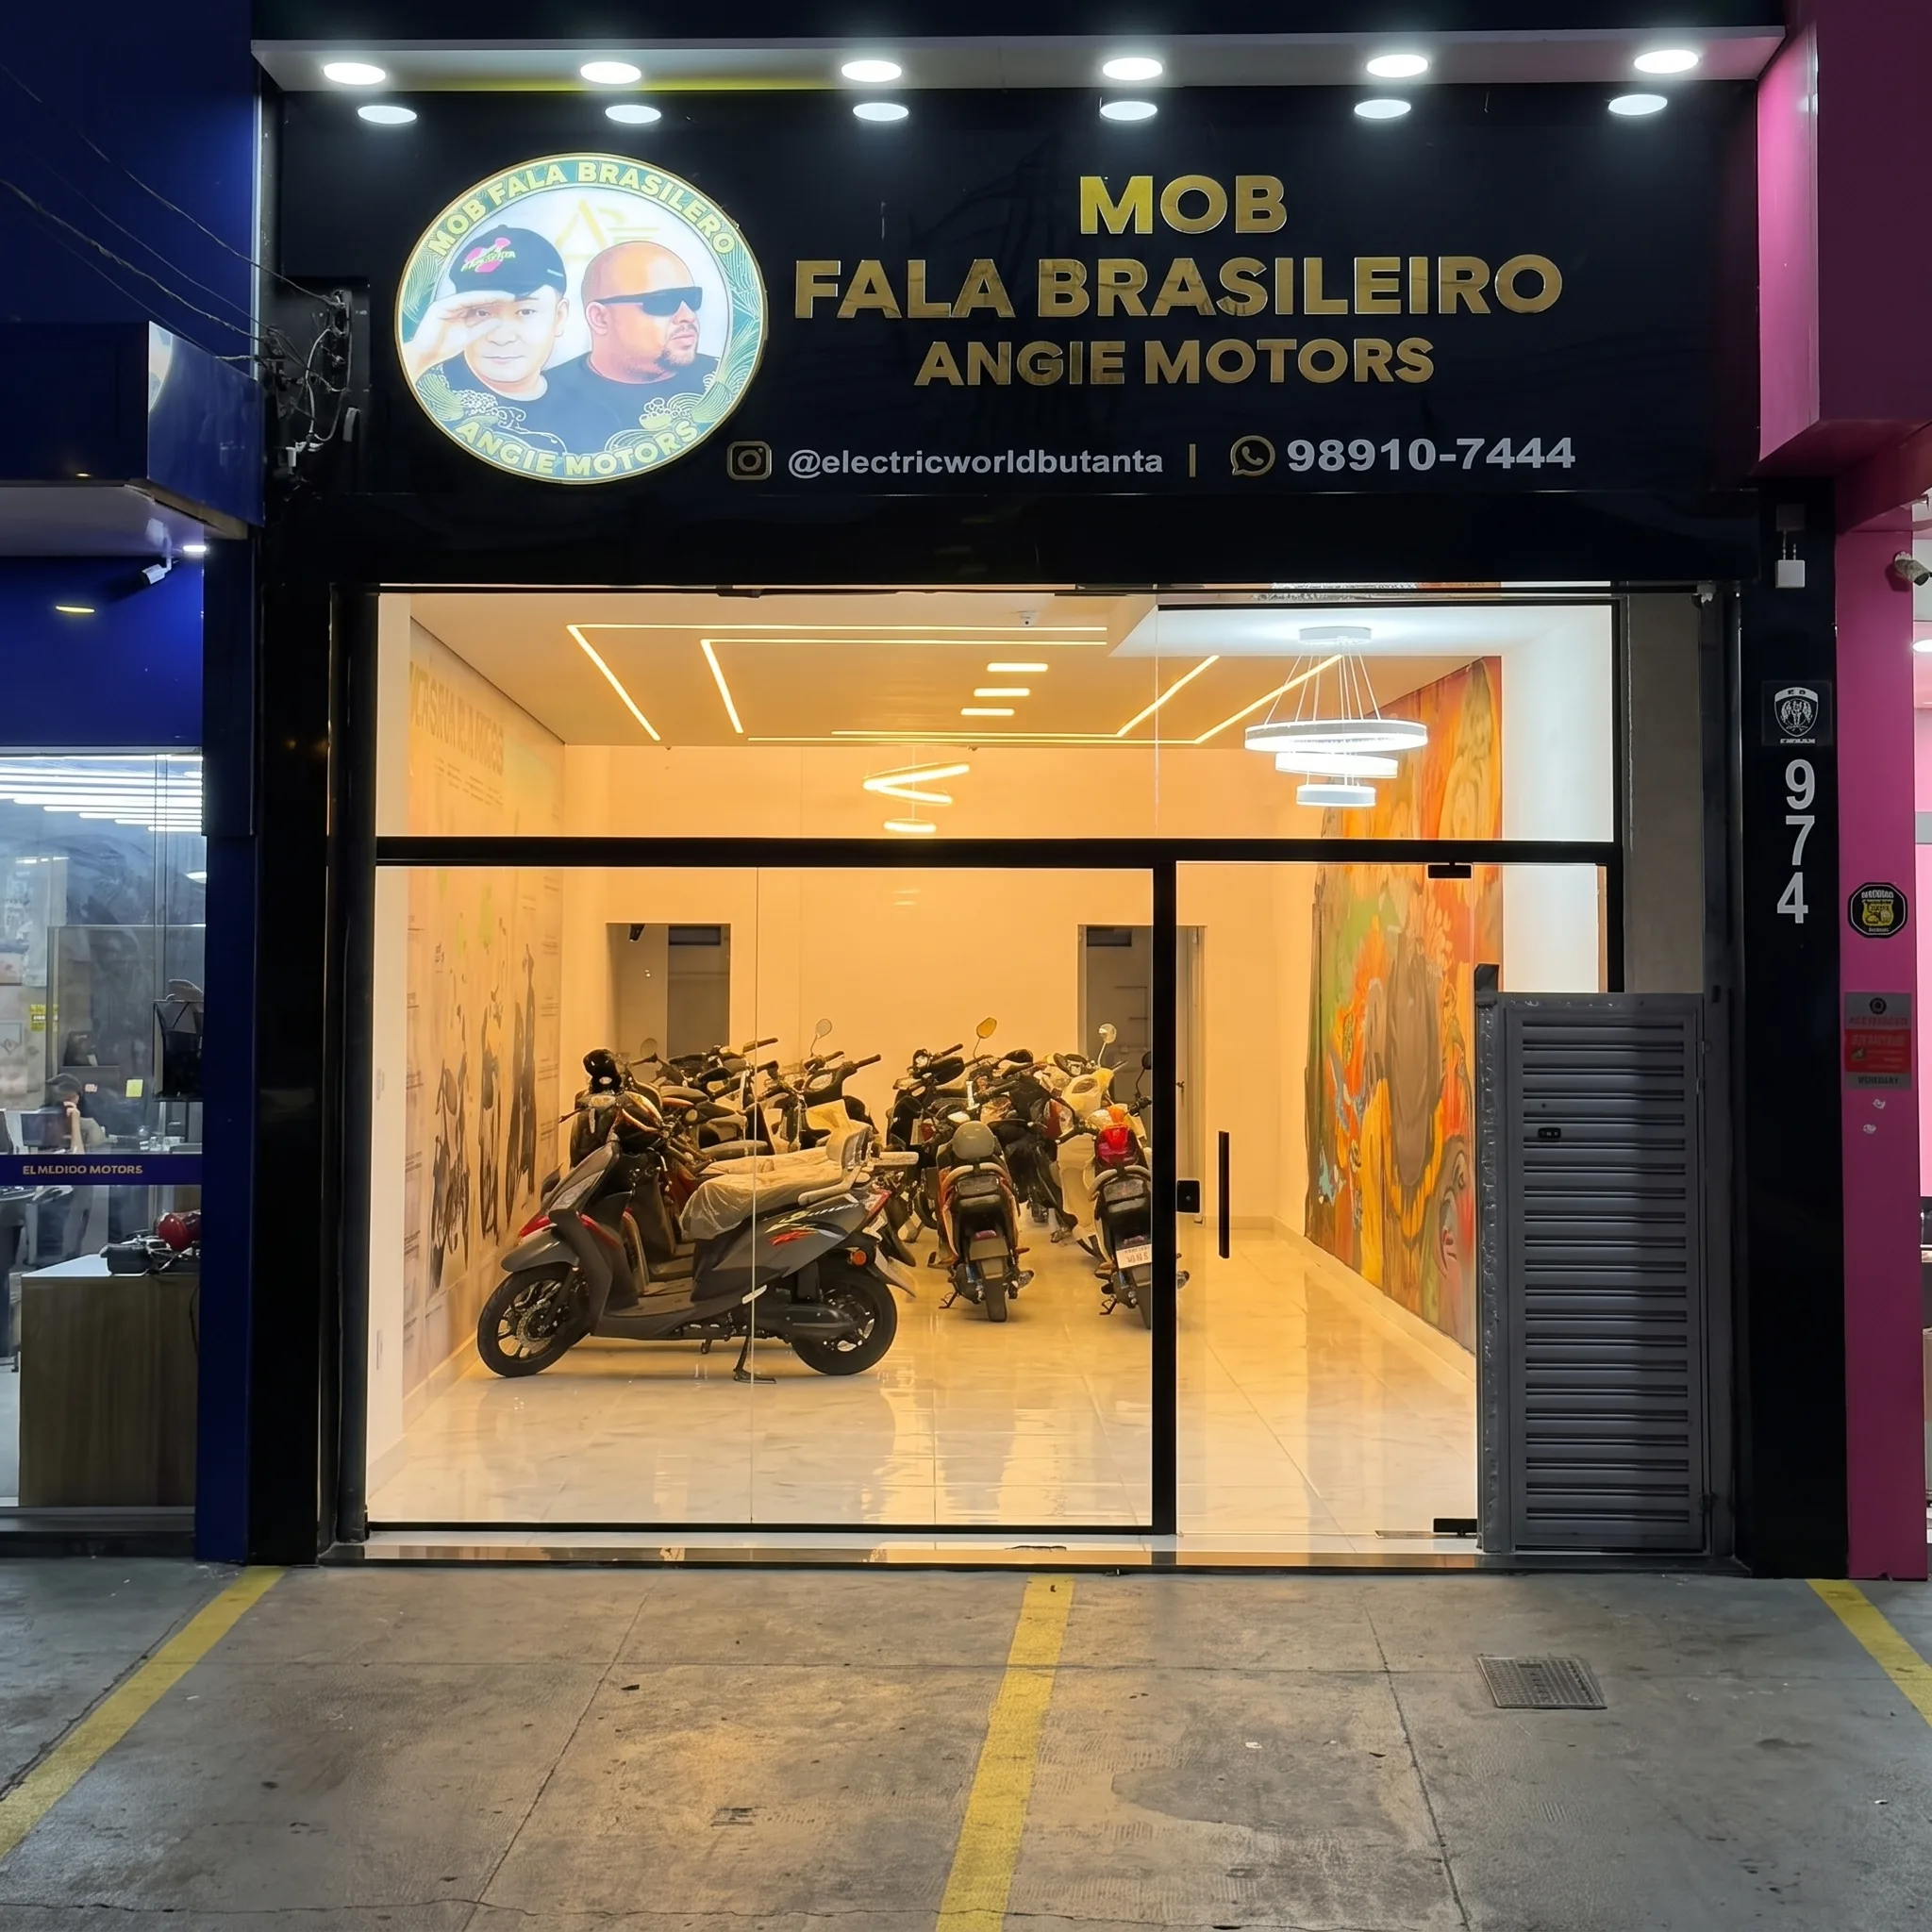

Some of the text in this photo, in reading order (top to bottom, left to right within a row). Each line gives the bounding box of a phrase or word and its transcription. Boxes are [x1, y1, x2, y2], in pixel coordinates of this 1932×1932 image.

[427, 199, 487, 258] MOB
[487, 164, 568, 207] FALA
[577, 161, 736, 255] BRASILERO
[1079, 174, 1288, 235] MOB
[794, 254, 1563, 319] FALA BRASILEIRO
[913, 337, 1434, 387] ANGIE MOTORS
[454, 420, 698, 476] ANGIE MOTORS
[788, 437, 1576, 479] @electricworldbutanta 98910-7444
[1776, 758, 1816, 924] 974
[23, 1165, 36, 1175] EL
[89, 1165, 143, 1174] MOTORS
